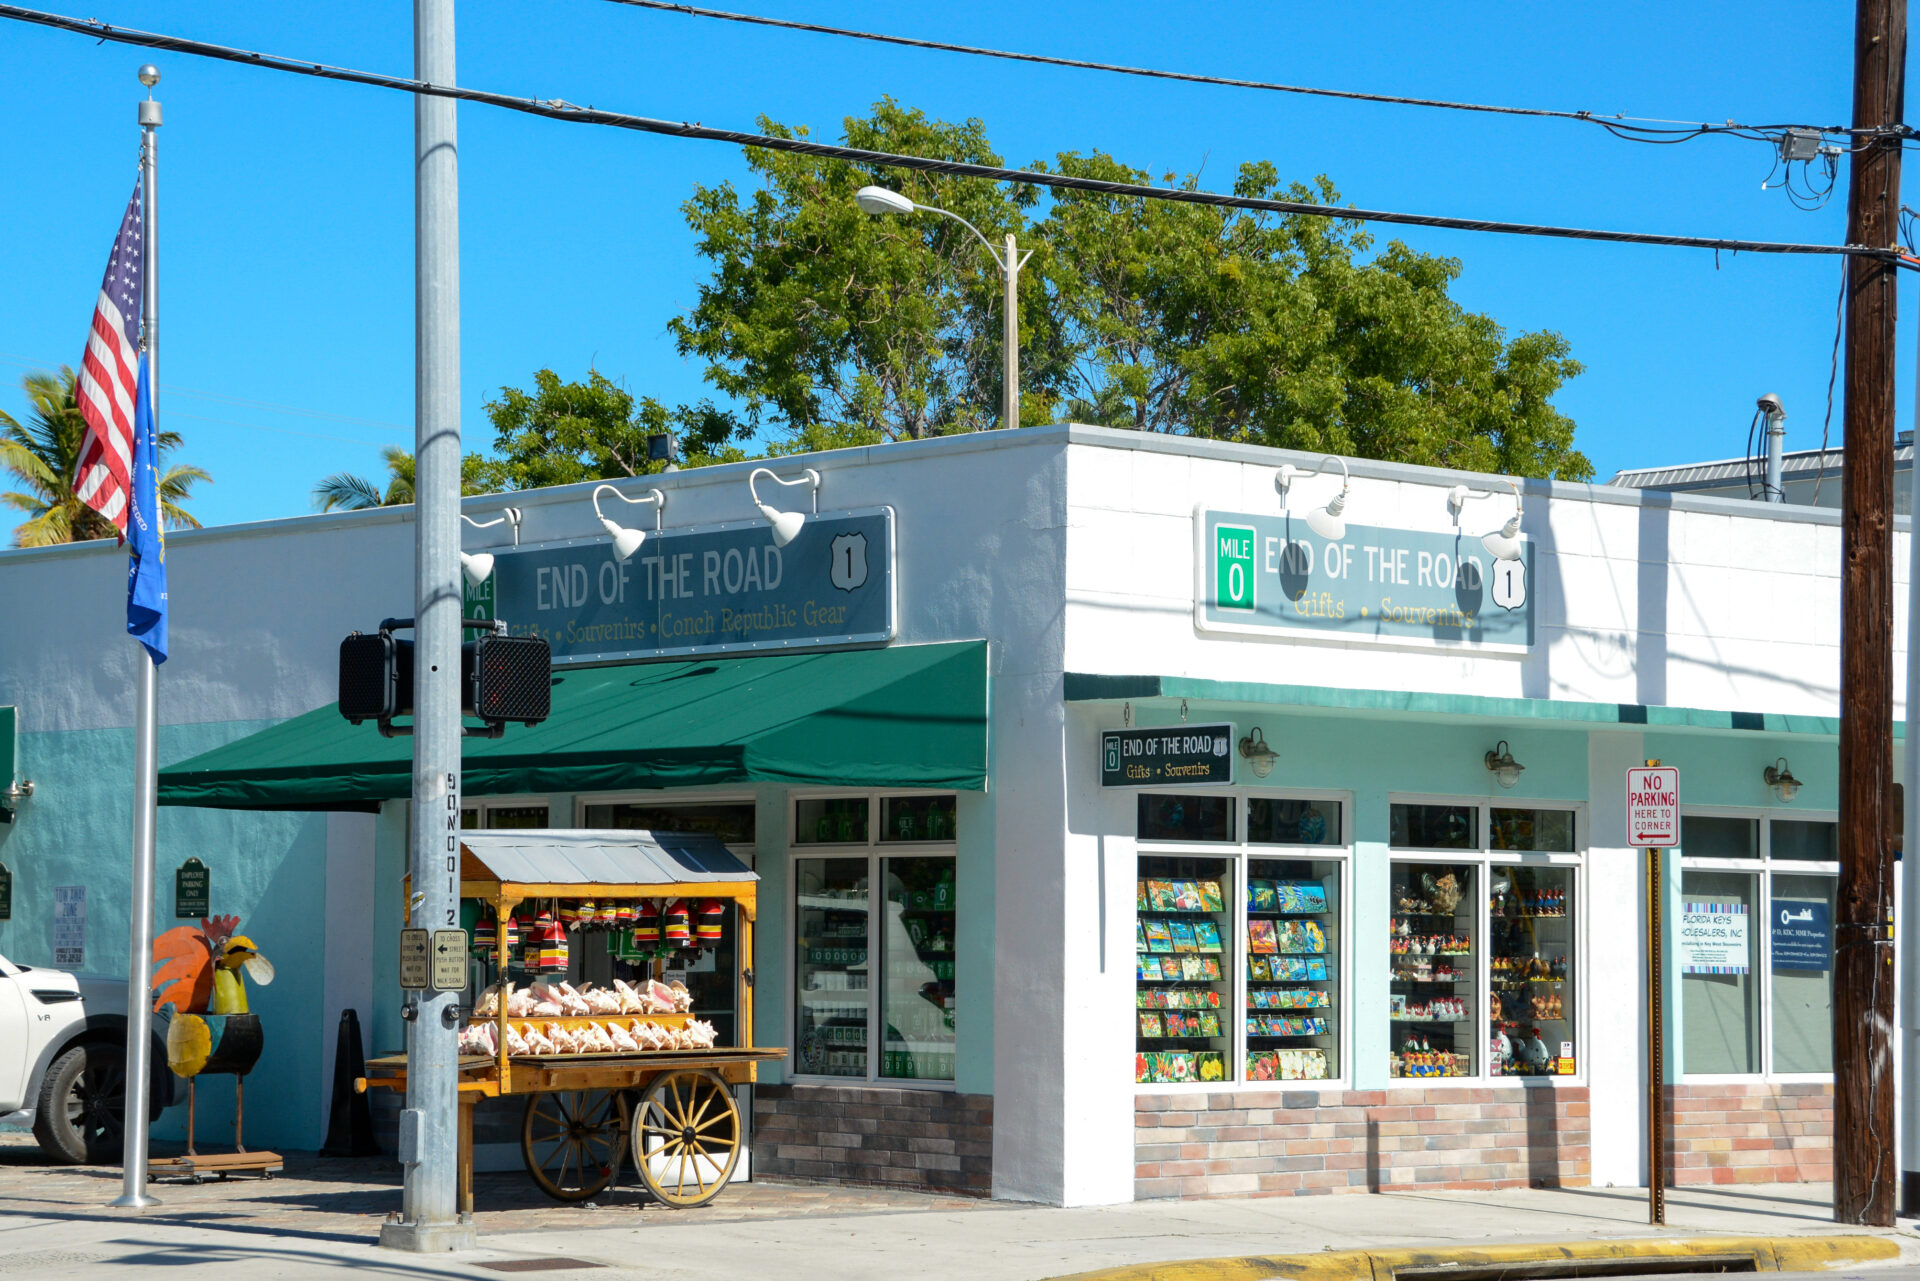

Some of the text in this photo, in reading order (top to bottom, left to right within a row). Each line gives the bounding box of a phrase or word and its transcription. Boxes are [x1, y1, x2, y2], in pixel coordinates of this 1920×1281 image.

[1220, 537, 1250, 560] MILE
[846, 546, 852, 578] 1
[1265, 536, 1484, 590] END OF THE ROAD
[537, 546, 783, 611] END OF THE ROAD
[1228, 562, 1244, 602] 0
[1506, 569, 1512, 598] 1
[466, 580, 491, 602] MILE
[1294, 590, 1474, 629] Gifts Souvenirs
[566, 616, 645, 643] Souvenirs
[661, 608, 718, 638] Conch
[721, 603, 797, 637] Republic
[804, 599, 847, 628] Gear
[1106, 742, 1118, 750] MILE
[1123, 736, 1211, 756] END OF THE ROAD
[1218, 742, 1222, 752] 1
[1109, 752, 1116, 767] 0
[1126, 762, 1210, 778] Gifts Souvenirs
[1644, 776, 1662, 790] NO
[1631, 792, 1675, 806] PARKING
[1635, 810, 1671, 818] HERE TO
[1635, 822, 1671, 830] CORNER
[56, 888, 68, 902] TOW
[63, 903, 78, 916] ZONE
[1714, 916, 1732, 924] KEYS
